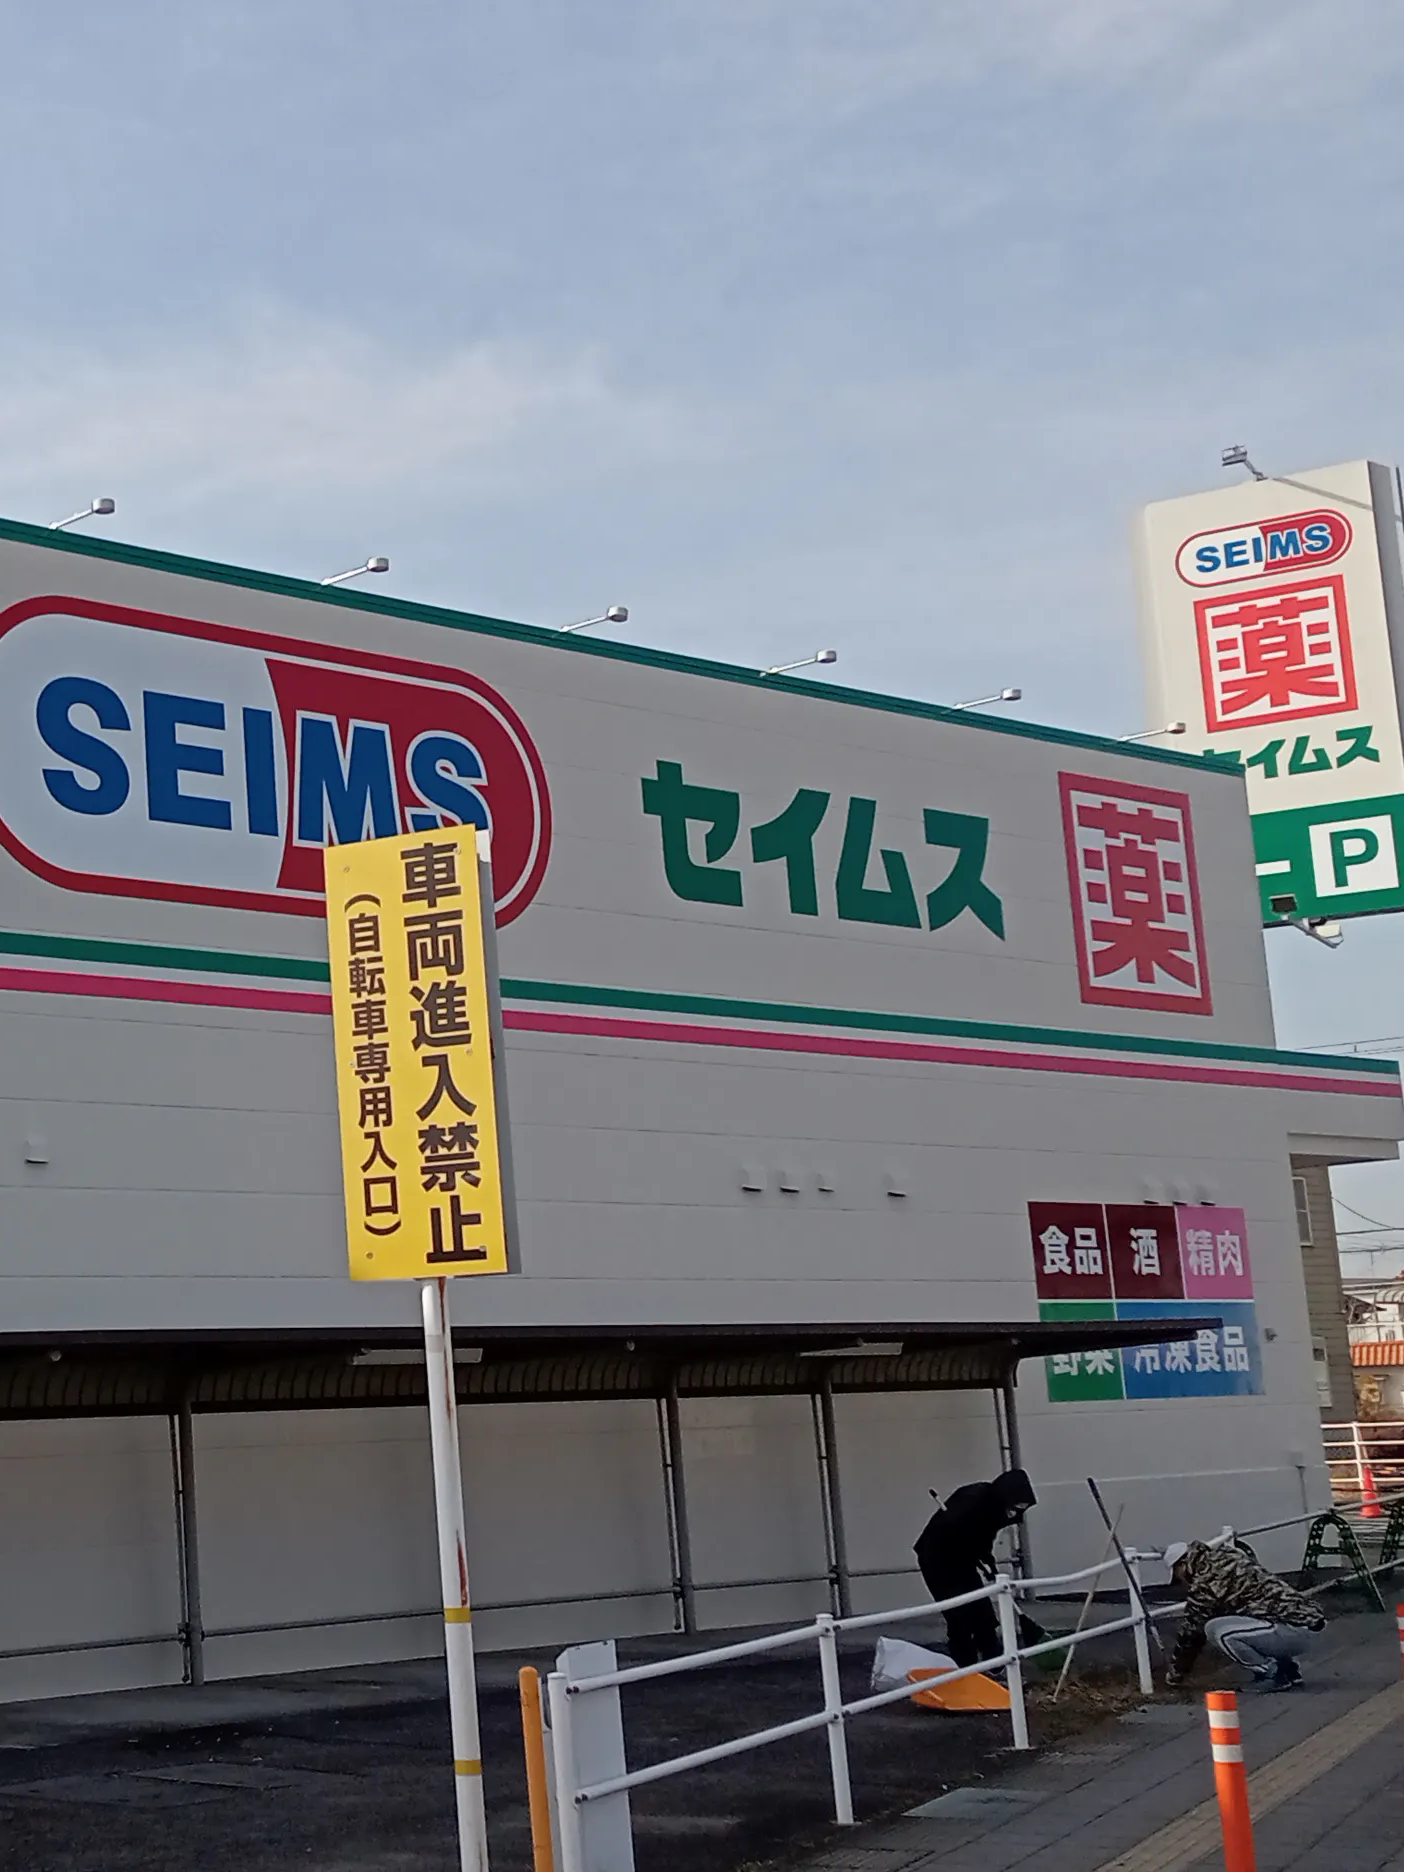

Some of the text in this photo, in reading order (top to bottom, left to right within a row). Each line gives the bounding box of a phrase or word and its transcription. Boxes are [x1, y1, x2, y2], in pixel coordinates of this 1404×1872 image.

[1195, 524, 1332, 573] SEIMS
[1210, 596, 1341, 717] 薬
[36, 676, 489, 844] SEIMS
[641, 760, 1005, 941] セイムス
[1077, 801, 1197, 989] 薬
[1330, 828, 1379, 888] P
[399, 842, 487, 1265] 車両進入禁止
[1039, 1226, 1103, 1275] 食品
[1130, 1228, 1161, 1276] 酒
[1187, 1229, 1244, 1276] 精肉
